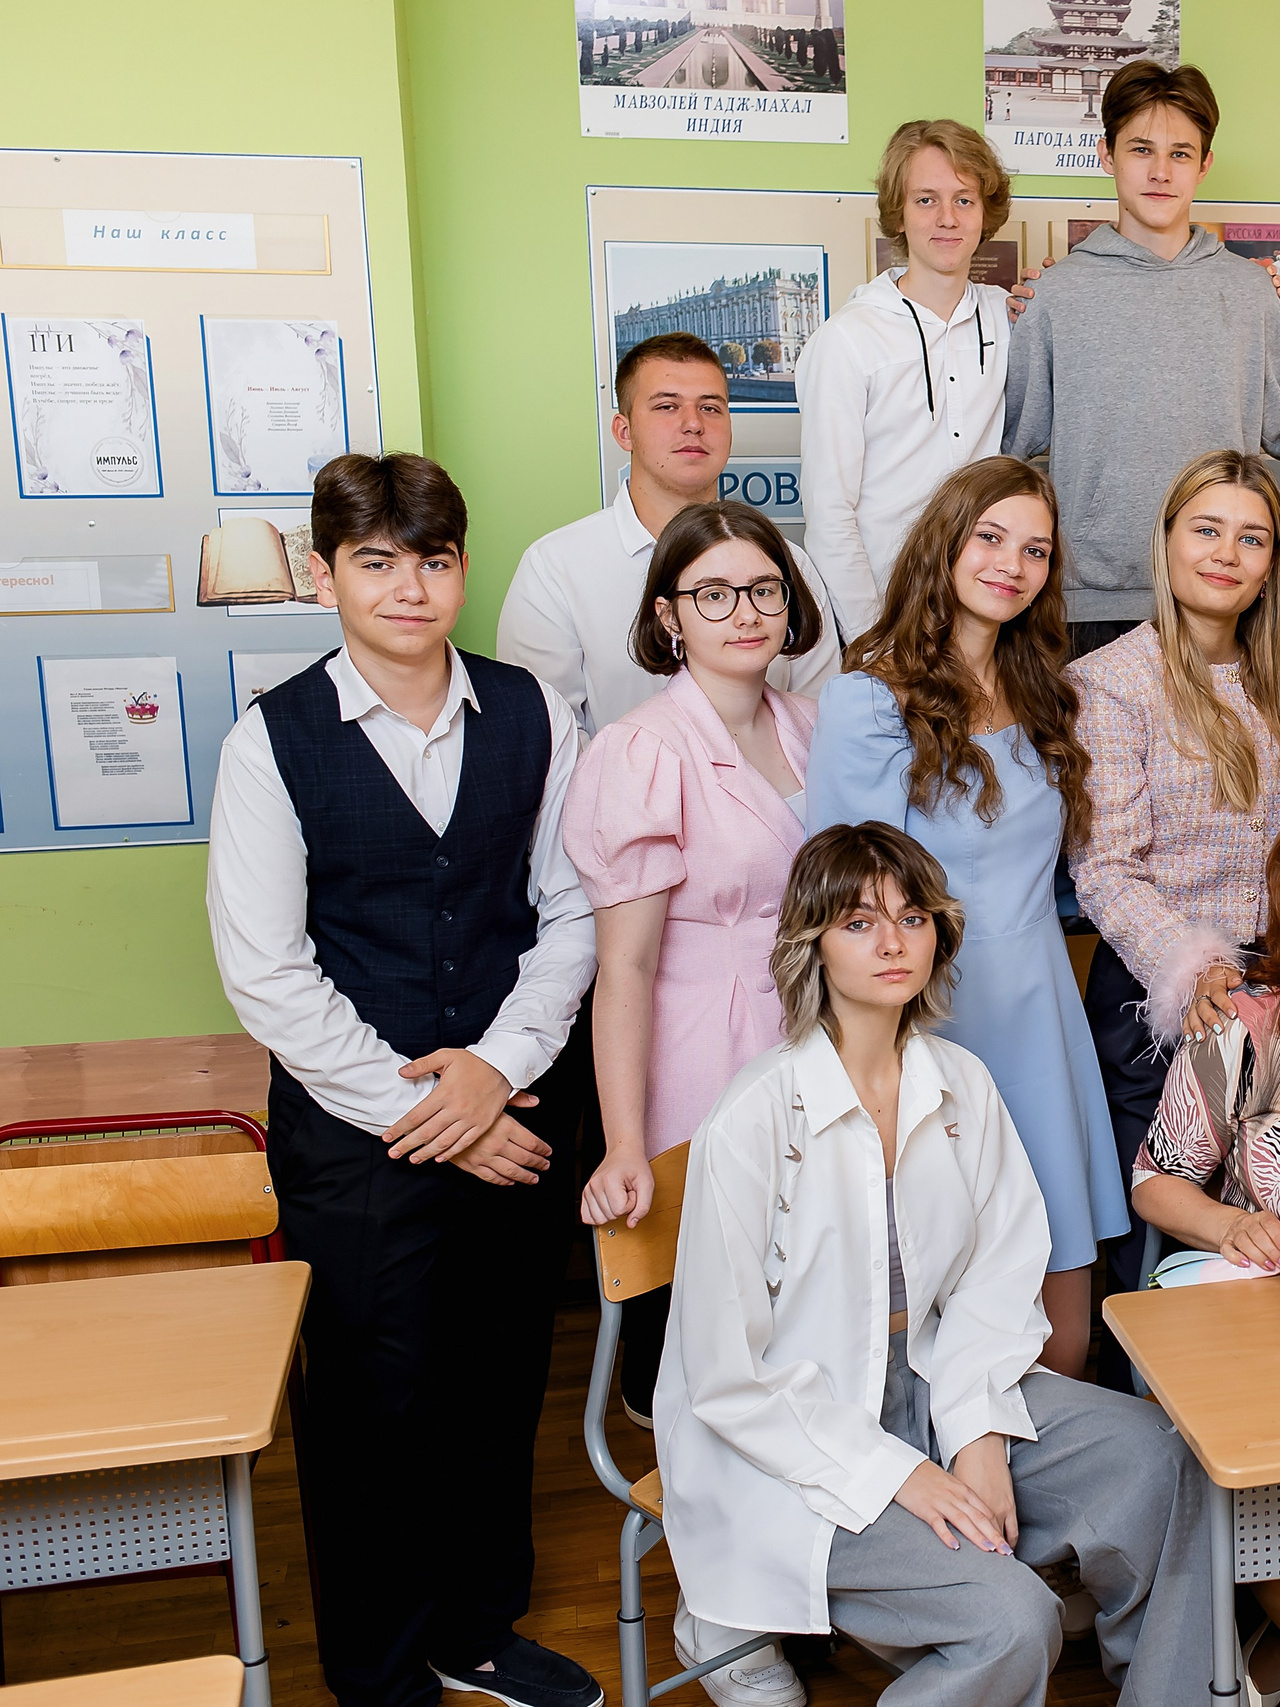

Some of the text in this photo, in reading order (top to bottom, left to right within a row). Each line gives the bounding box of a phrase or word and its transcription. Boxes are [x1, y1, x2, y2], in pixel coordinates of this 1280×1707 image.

[613, 92, 812, 114] МАВЗОЛЕЙ ТАДЖ-МАХАЛ
[686, 117, 744, 136] ИНДИЯ
[1014, 131, 1073, 149] ПАГОДА
[93, 224, 228, 241] Наш класс
[1226, 227, 1262, 240] РУССКАЯ
[96, 455, 138, 467] ИМПУЛЬС
[718, 471, 801, 507] РОВ
[0, 573, 55, 589] ересно!
